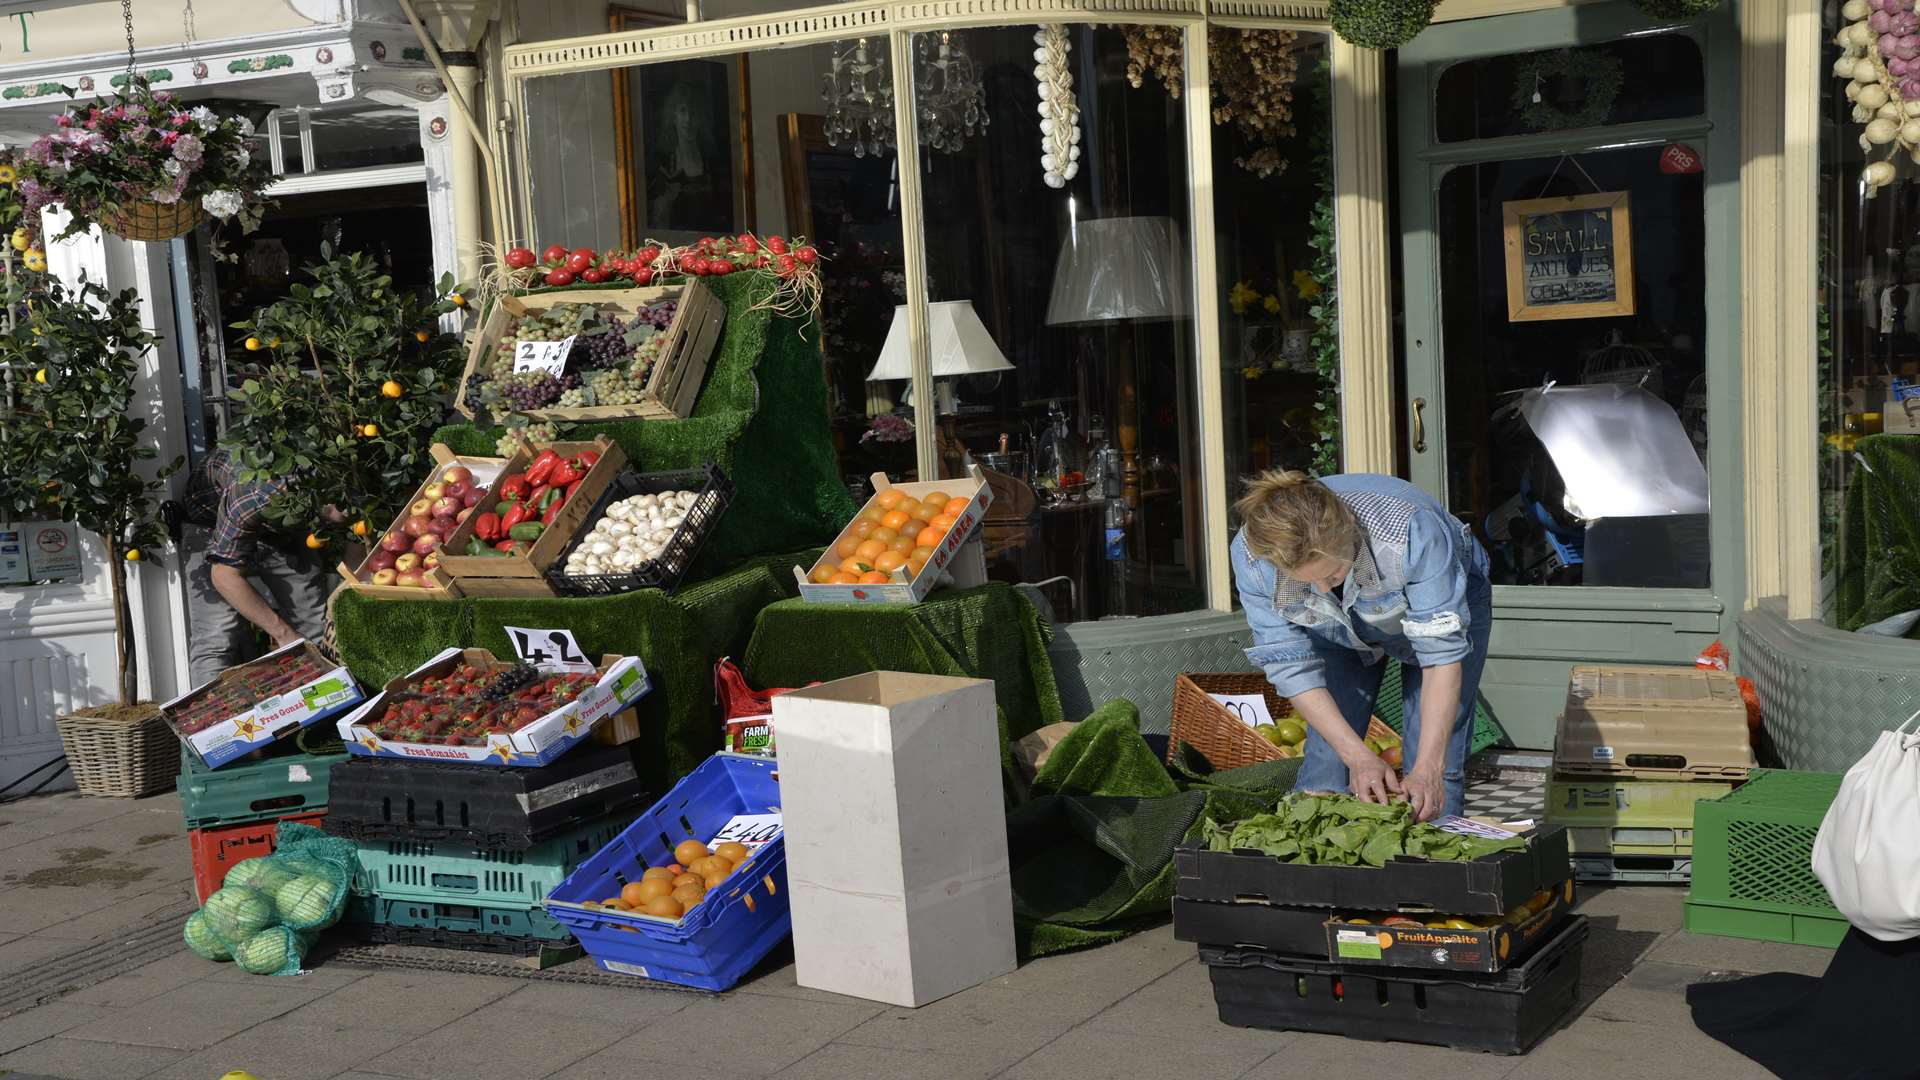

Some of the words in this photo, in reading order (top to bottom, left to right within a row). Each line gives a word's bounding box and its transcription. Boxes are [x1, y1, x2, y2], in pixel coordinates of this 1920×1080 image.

[1668, 147, 1694, 168] PRS
[1528, 228, 1606, 256] SMALL
[1531, 283, 1568, 300] OPEN
[521, 343, 536, 359] 2
[259, 713, 280, 725] Fres
[581, 705, 596, 720] Fres
[744, 725, 769, 738] FARM
[743, 734, 769, 748] FRESH
[402, 746, 426, 756] Fres
